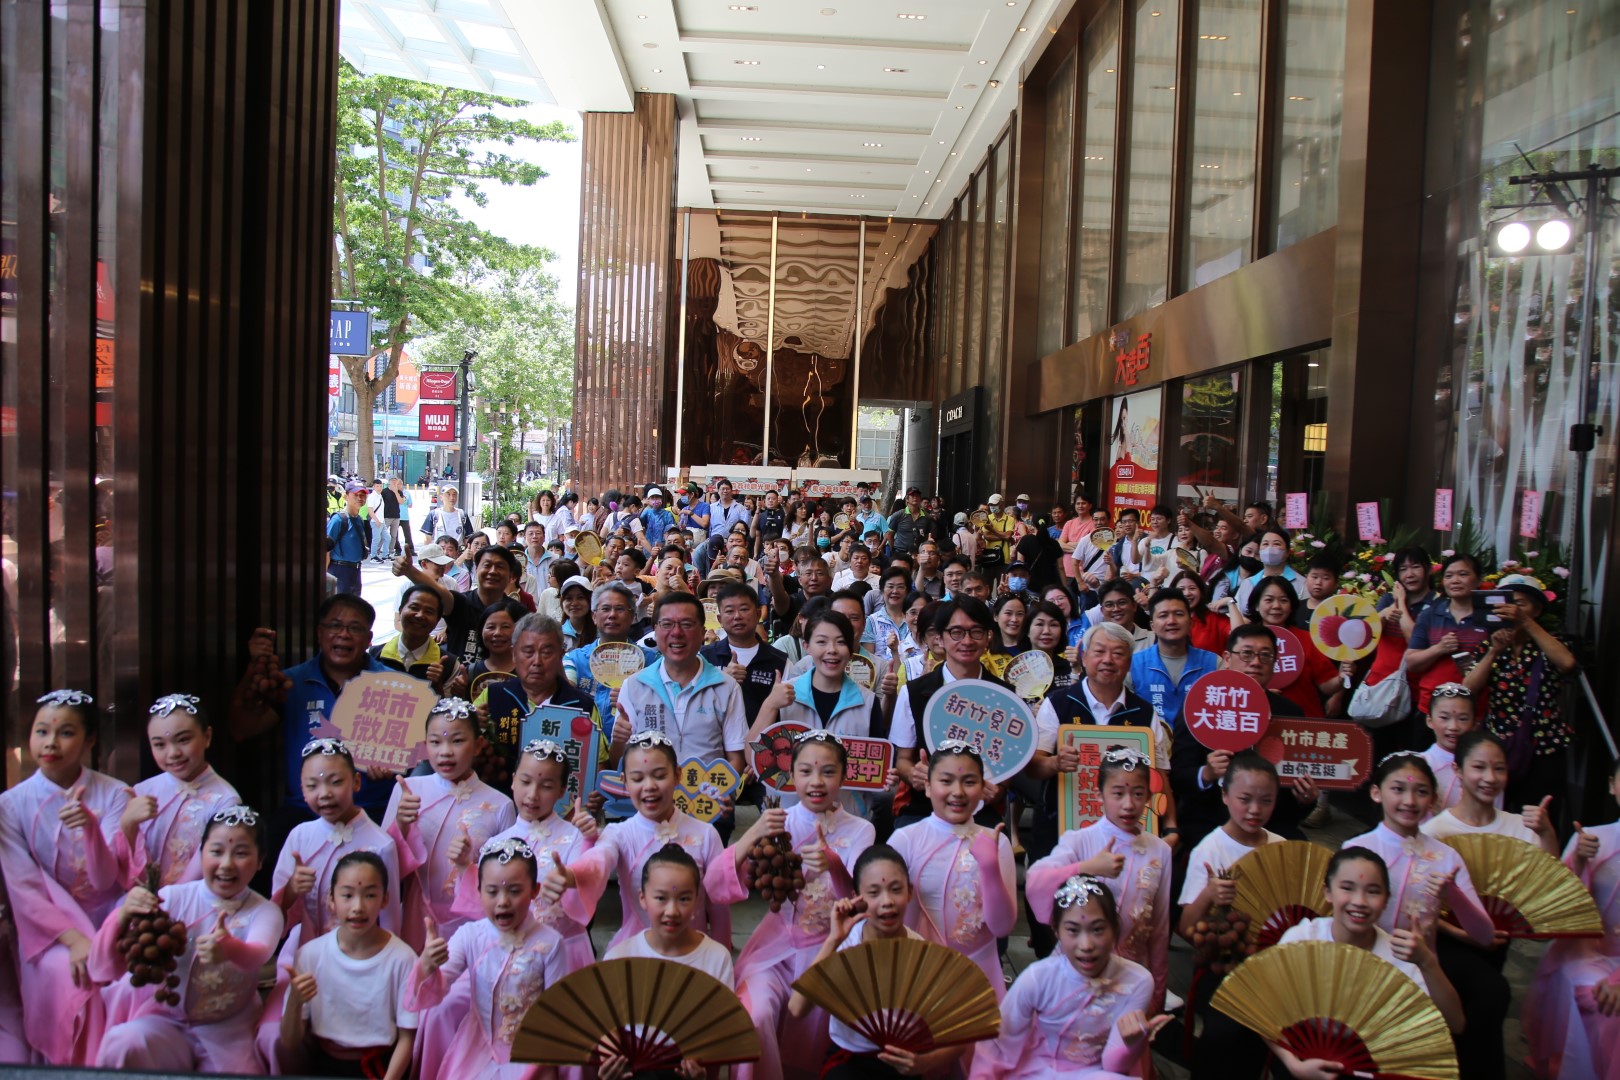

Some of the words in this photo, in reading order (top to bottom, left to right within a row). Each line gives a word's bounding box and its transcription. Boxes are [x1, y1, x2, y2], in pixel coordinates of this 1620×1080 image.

[424, 414, 450, 426] MUJI
[946, 405, 963, 422] COACH
[358, 687, 421, 718] 城市
[1205, 685, 1250, 708] 新竹
[945, 694, 1024, 737] 新竹夏日
[1193, 708, 1260, 733] 大遠百
[351, 714, 410, 748] 微風
[1281, 729, 1349, 749] 竹市農產
[687, 768, 728, 787] 童玩
[1282, 762, 1336, 777] 由你荔挺
